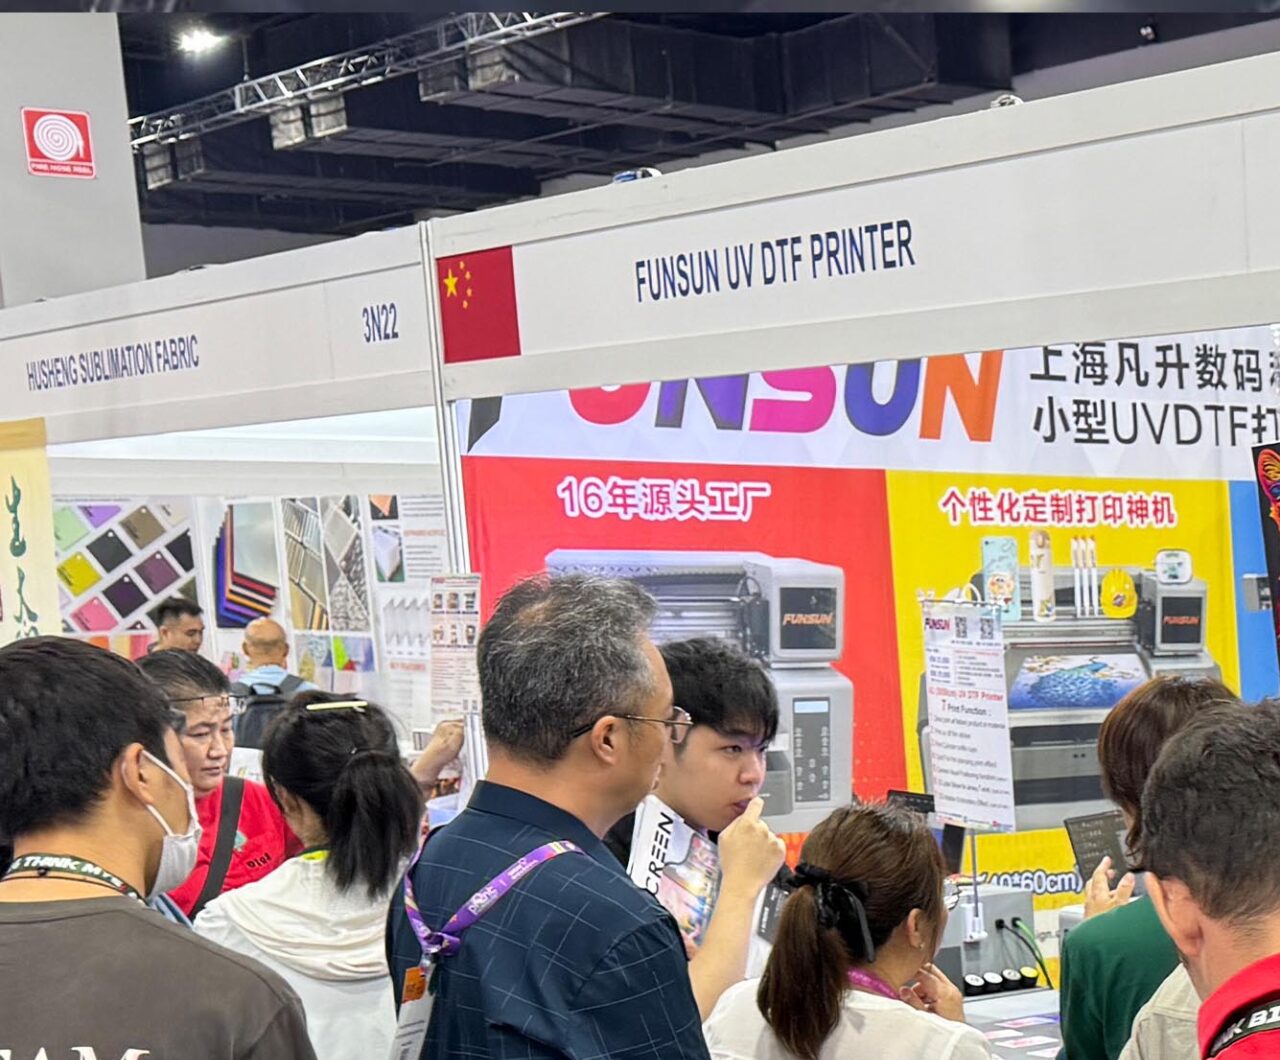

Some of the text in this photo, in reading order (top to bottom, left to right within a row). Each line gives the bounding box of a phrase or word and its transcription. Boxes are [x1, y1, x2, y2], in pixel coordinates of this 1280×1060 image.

[635, 219, 916, 303] FUNSUN UV DTF PRINTER
[362, 302, 399, 343] 3N22
[26, 334, 200, 391] HUSHENG SUBLIMATION FABRIC
[558, 477, 770, 520] 16年源头工厂
[941, 488, 1176, 526] 个性化定制打印神机
[782, 612, 834, 626] FUNSUN
[645, 812, 675, 896] CREEN
